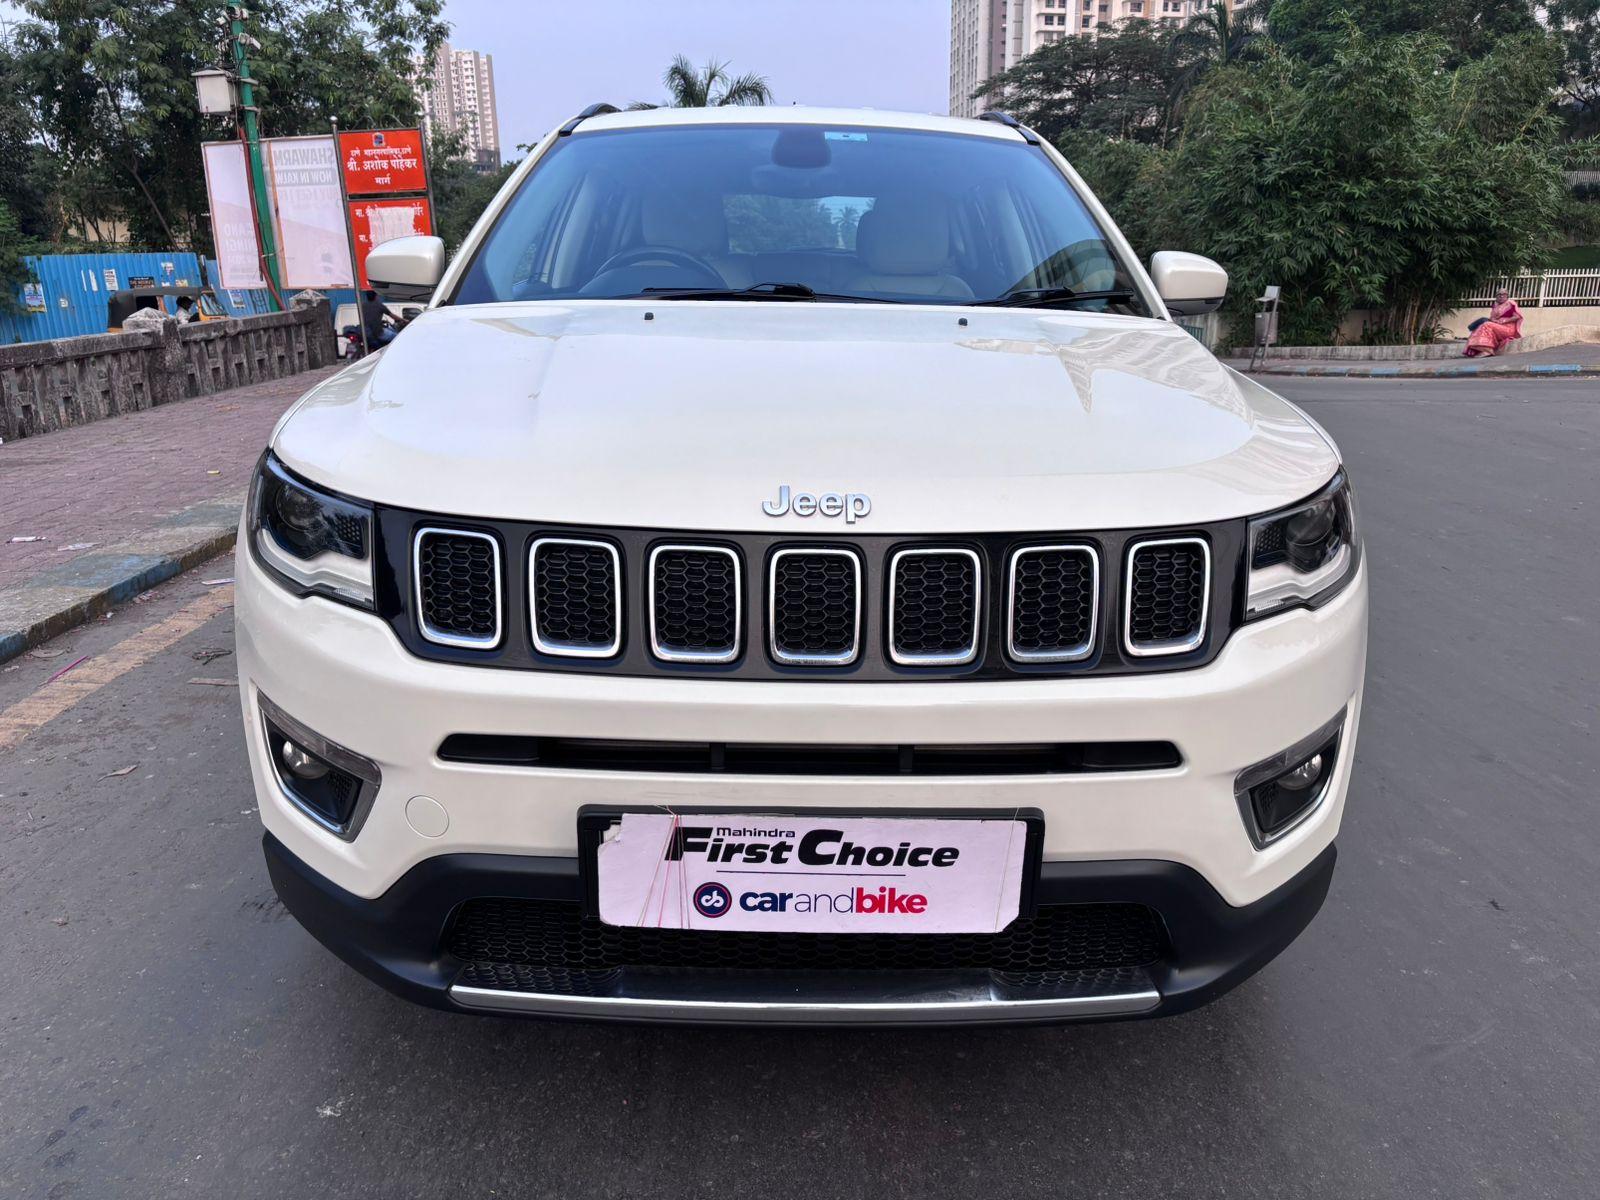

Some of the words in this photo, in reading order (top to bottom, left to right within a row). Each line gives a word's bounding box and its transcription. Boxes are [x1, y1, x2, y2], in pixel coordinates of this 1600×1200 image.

[362, 155, 389, 171] अशोक
[390, 154, 418, 171] पोहेकर
[374, 172, 392, 185] मार्ग
[761, 485, 872, 524] Jeep
[716, 827, 796, 838] Mahindra
[664, 826, 793, 864] First
[798, 829, 960, 867] Choice
[739, 886, 928, 914] carandbike
